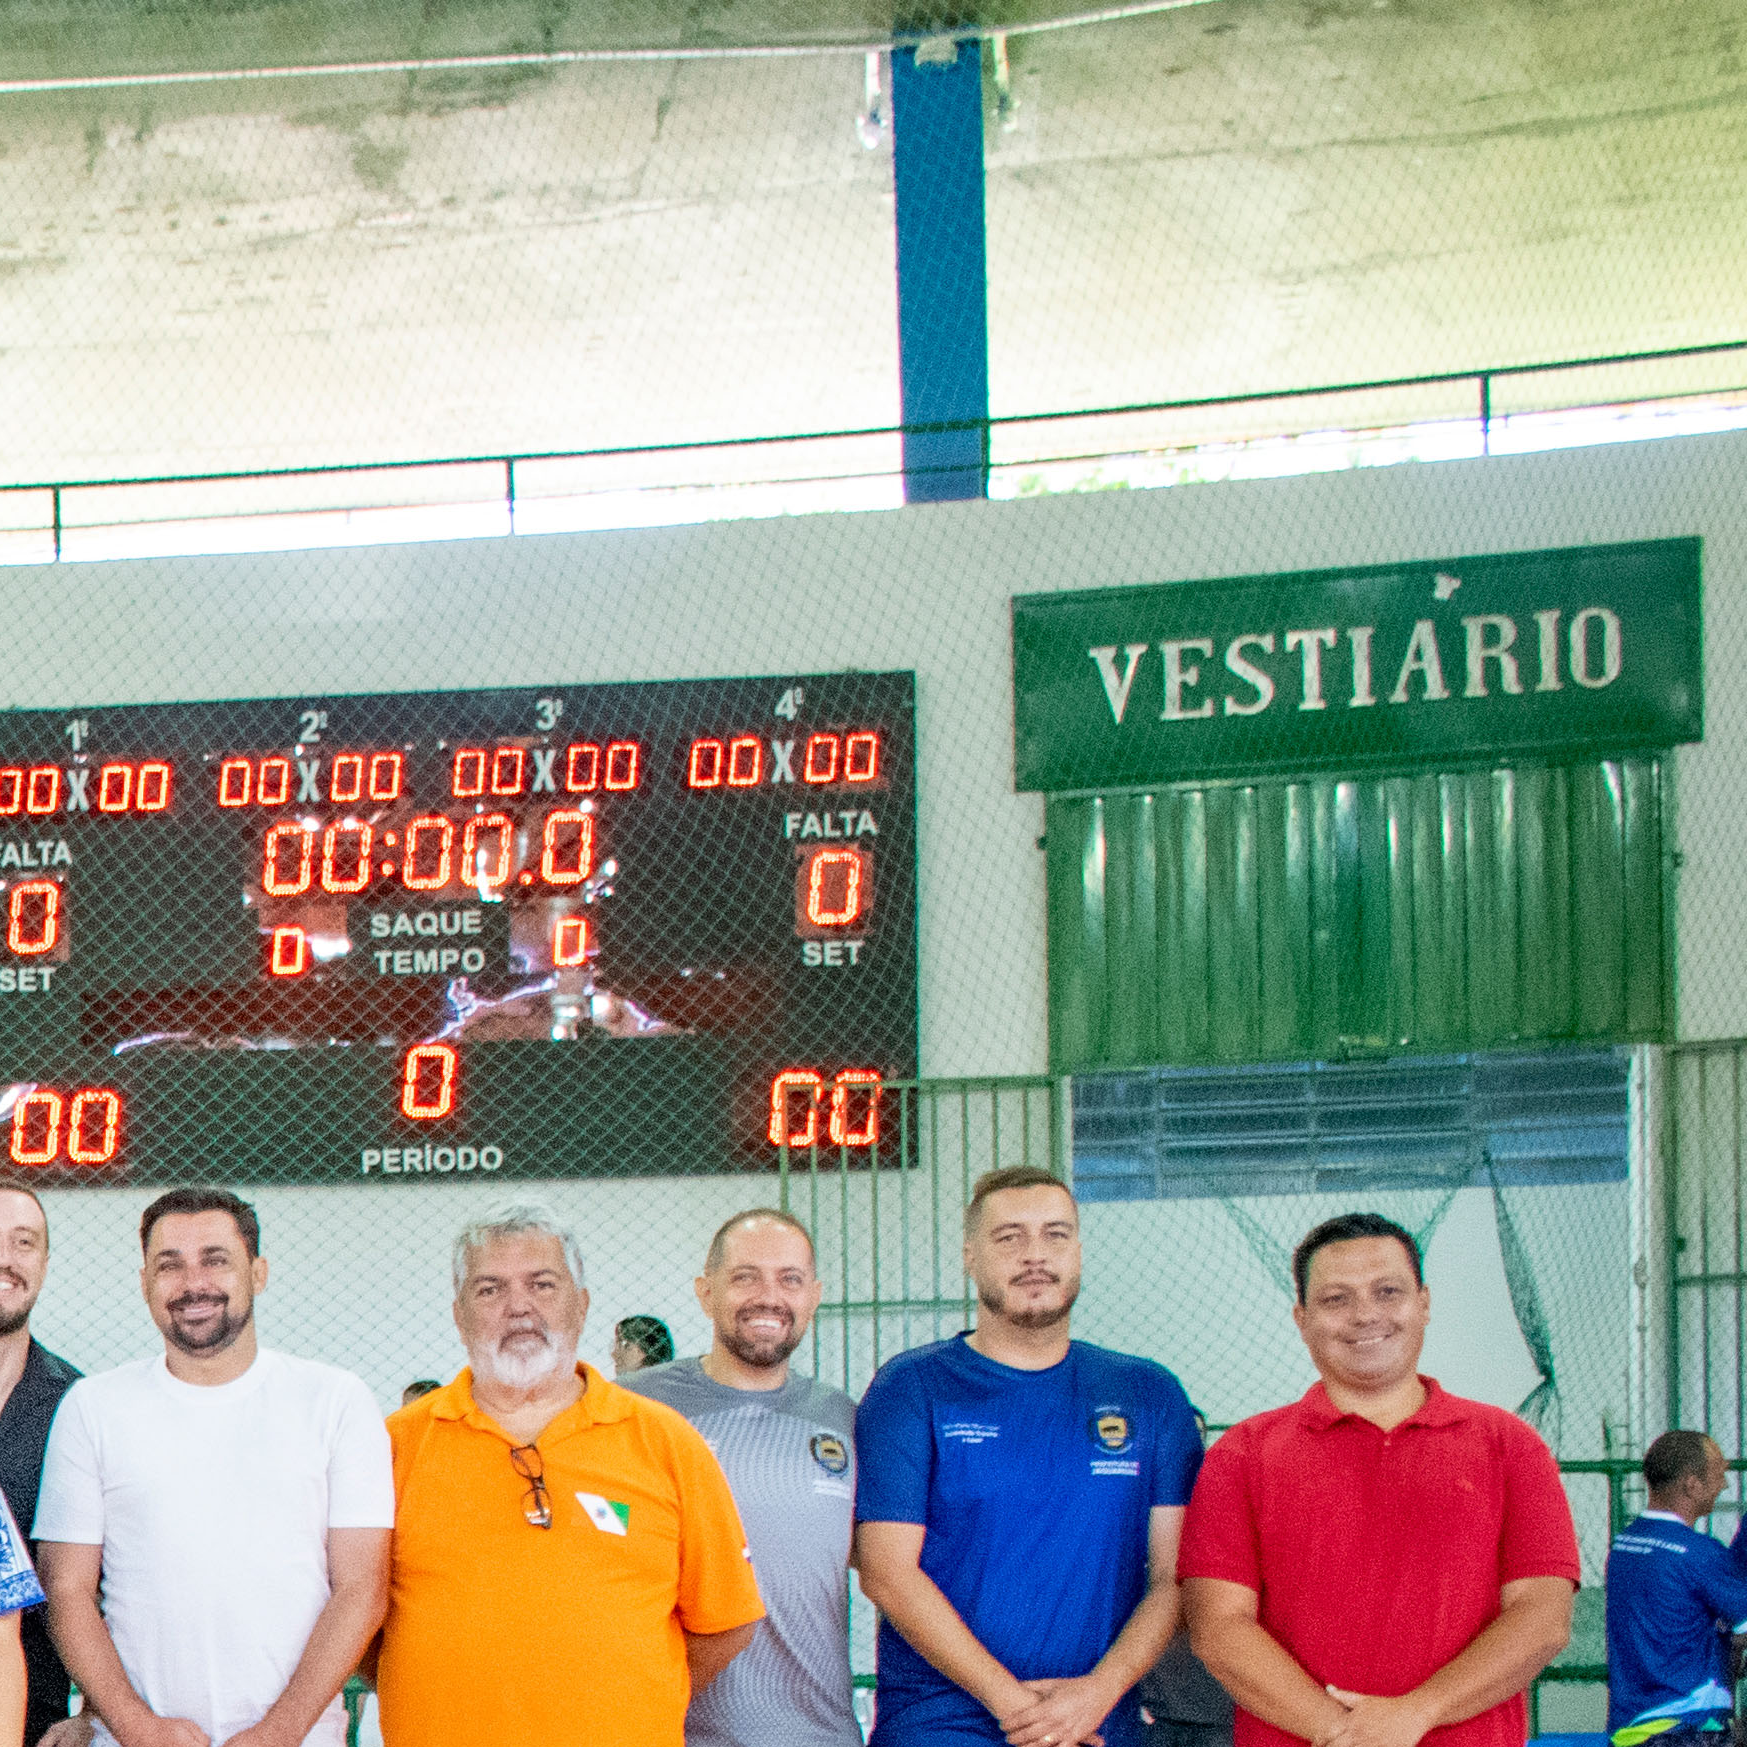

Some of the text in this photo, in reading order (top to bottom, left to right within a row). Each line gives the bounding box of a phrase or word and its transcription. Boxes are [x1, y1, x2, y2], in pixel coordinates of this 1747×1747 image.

[1089, 573, 1622, 727] VESTIÁRIO
[297, 759, 321, 802] X
[532, 749, 556, 792] X
[770, 740, 795, 783] X
[66, 769, 89, 812] X
[784, 810, 878, 838] FALTA
[809, 850, 862, 926] 0
[9, 880, 61, 955] 0
[369, 911, 483, 939] SAQUE
[374, 950, 486, 975] TEMPO
[803, 939, 862, 966] SET
[402, 1044, 457, 1120] 0
[9, 1089, 121, 1165] 00
[362, 1143, 504, 1174] PERÍODO
